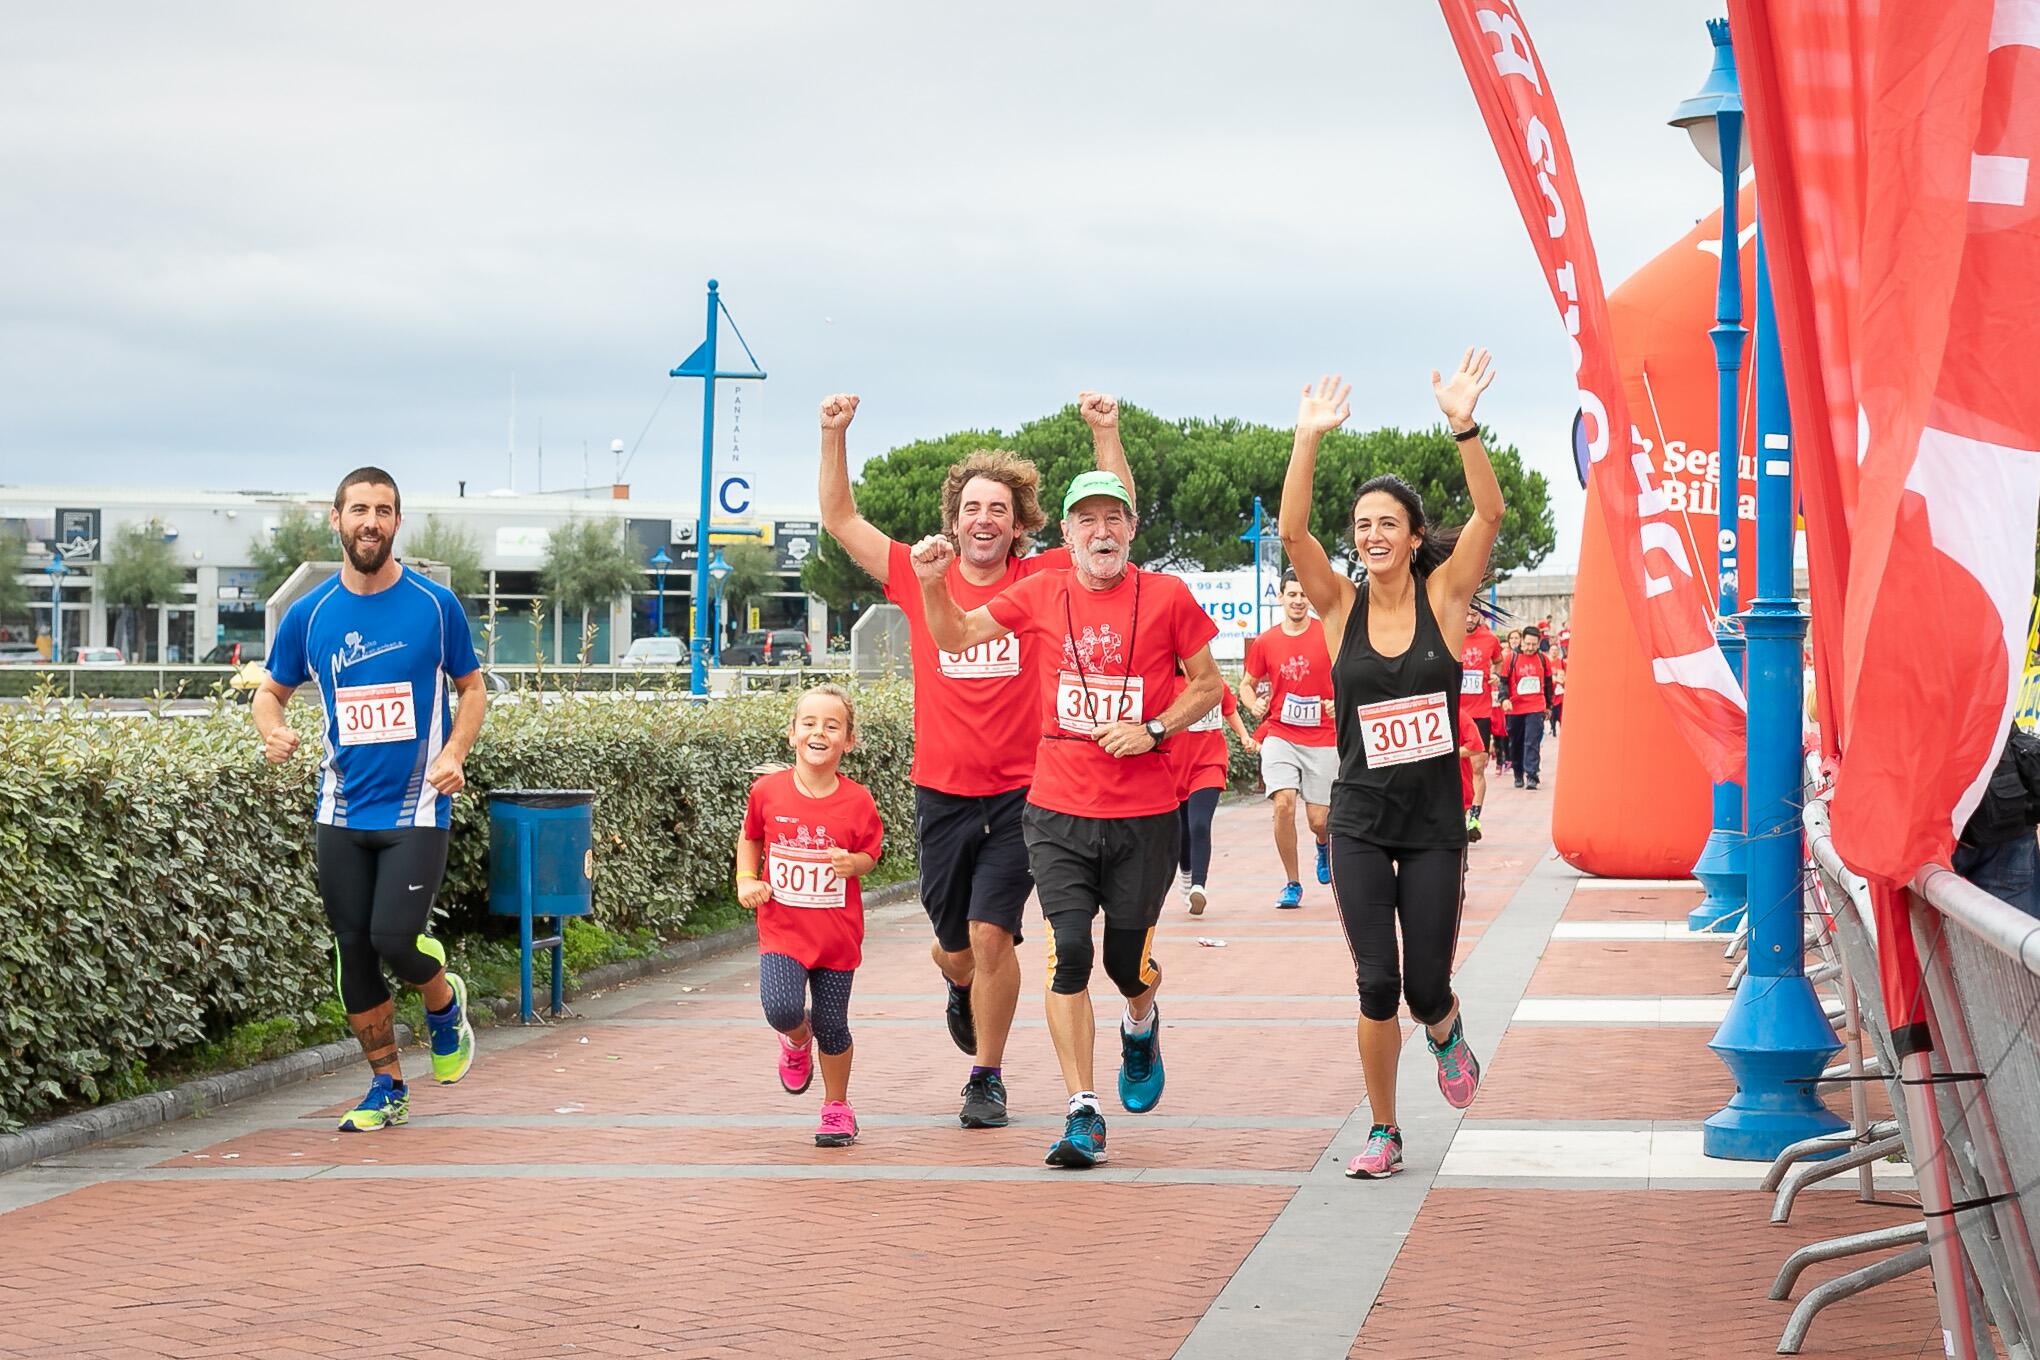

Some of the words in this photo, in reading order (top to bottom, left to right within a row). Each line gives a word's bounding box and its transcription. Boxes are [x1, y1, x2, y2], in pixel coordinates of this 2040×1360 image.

[732, 386, 742, 462] PANTALAN
[719, 477, 750, 514] C
[1216, 582, 1231, 590] 43
[1264, 583, 1277, 597] A
[345, 701, 406, 731] 3012
[1067, 689, 1133, 721] 3012
[1287, 704, 1317, 719] 1011
[1371, 712, 1443, 752] 3012
[776, 862, 837, 893] 3012
